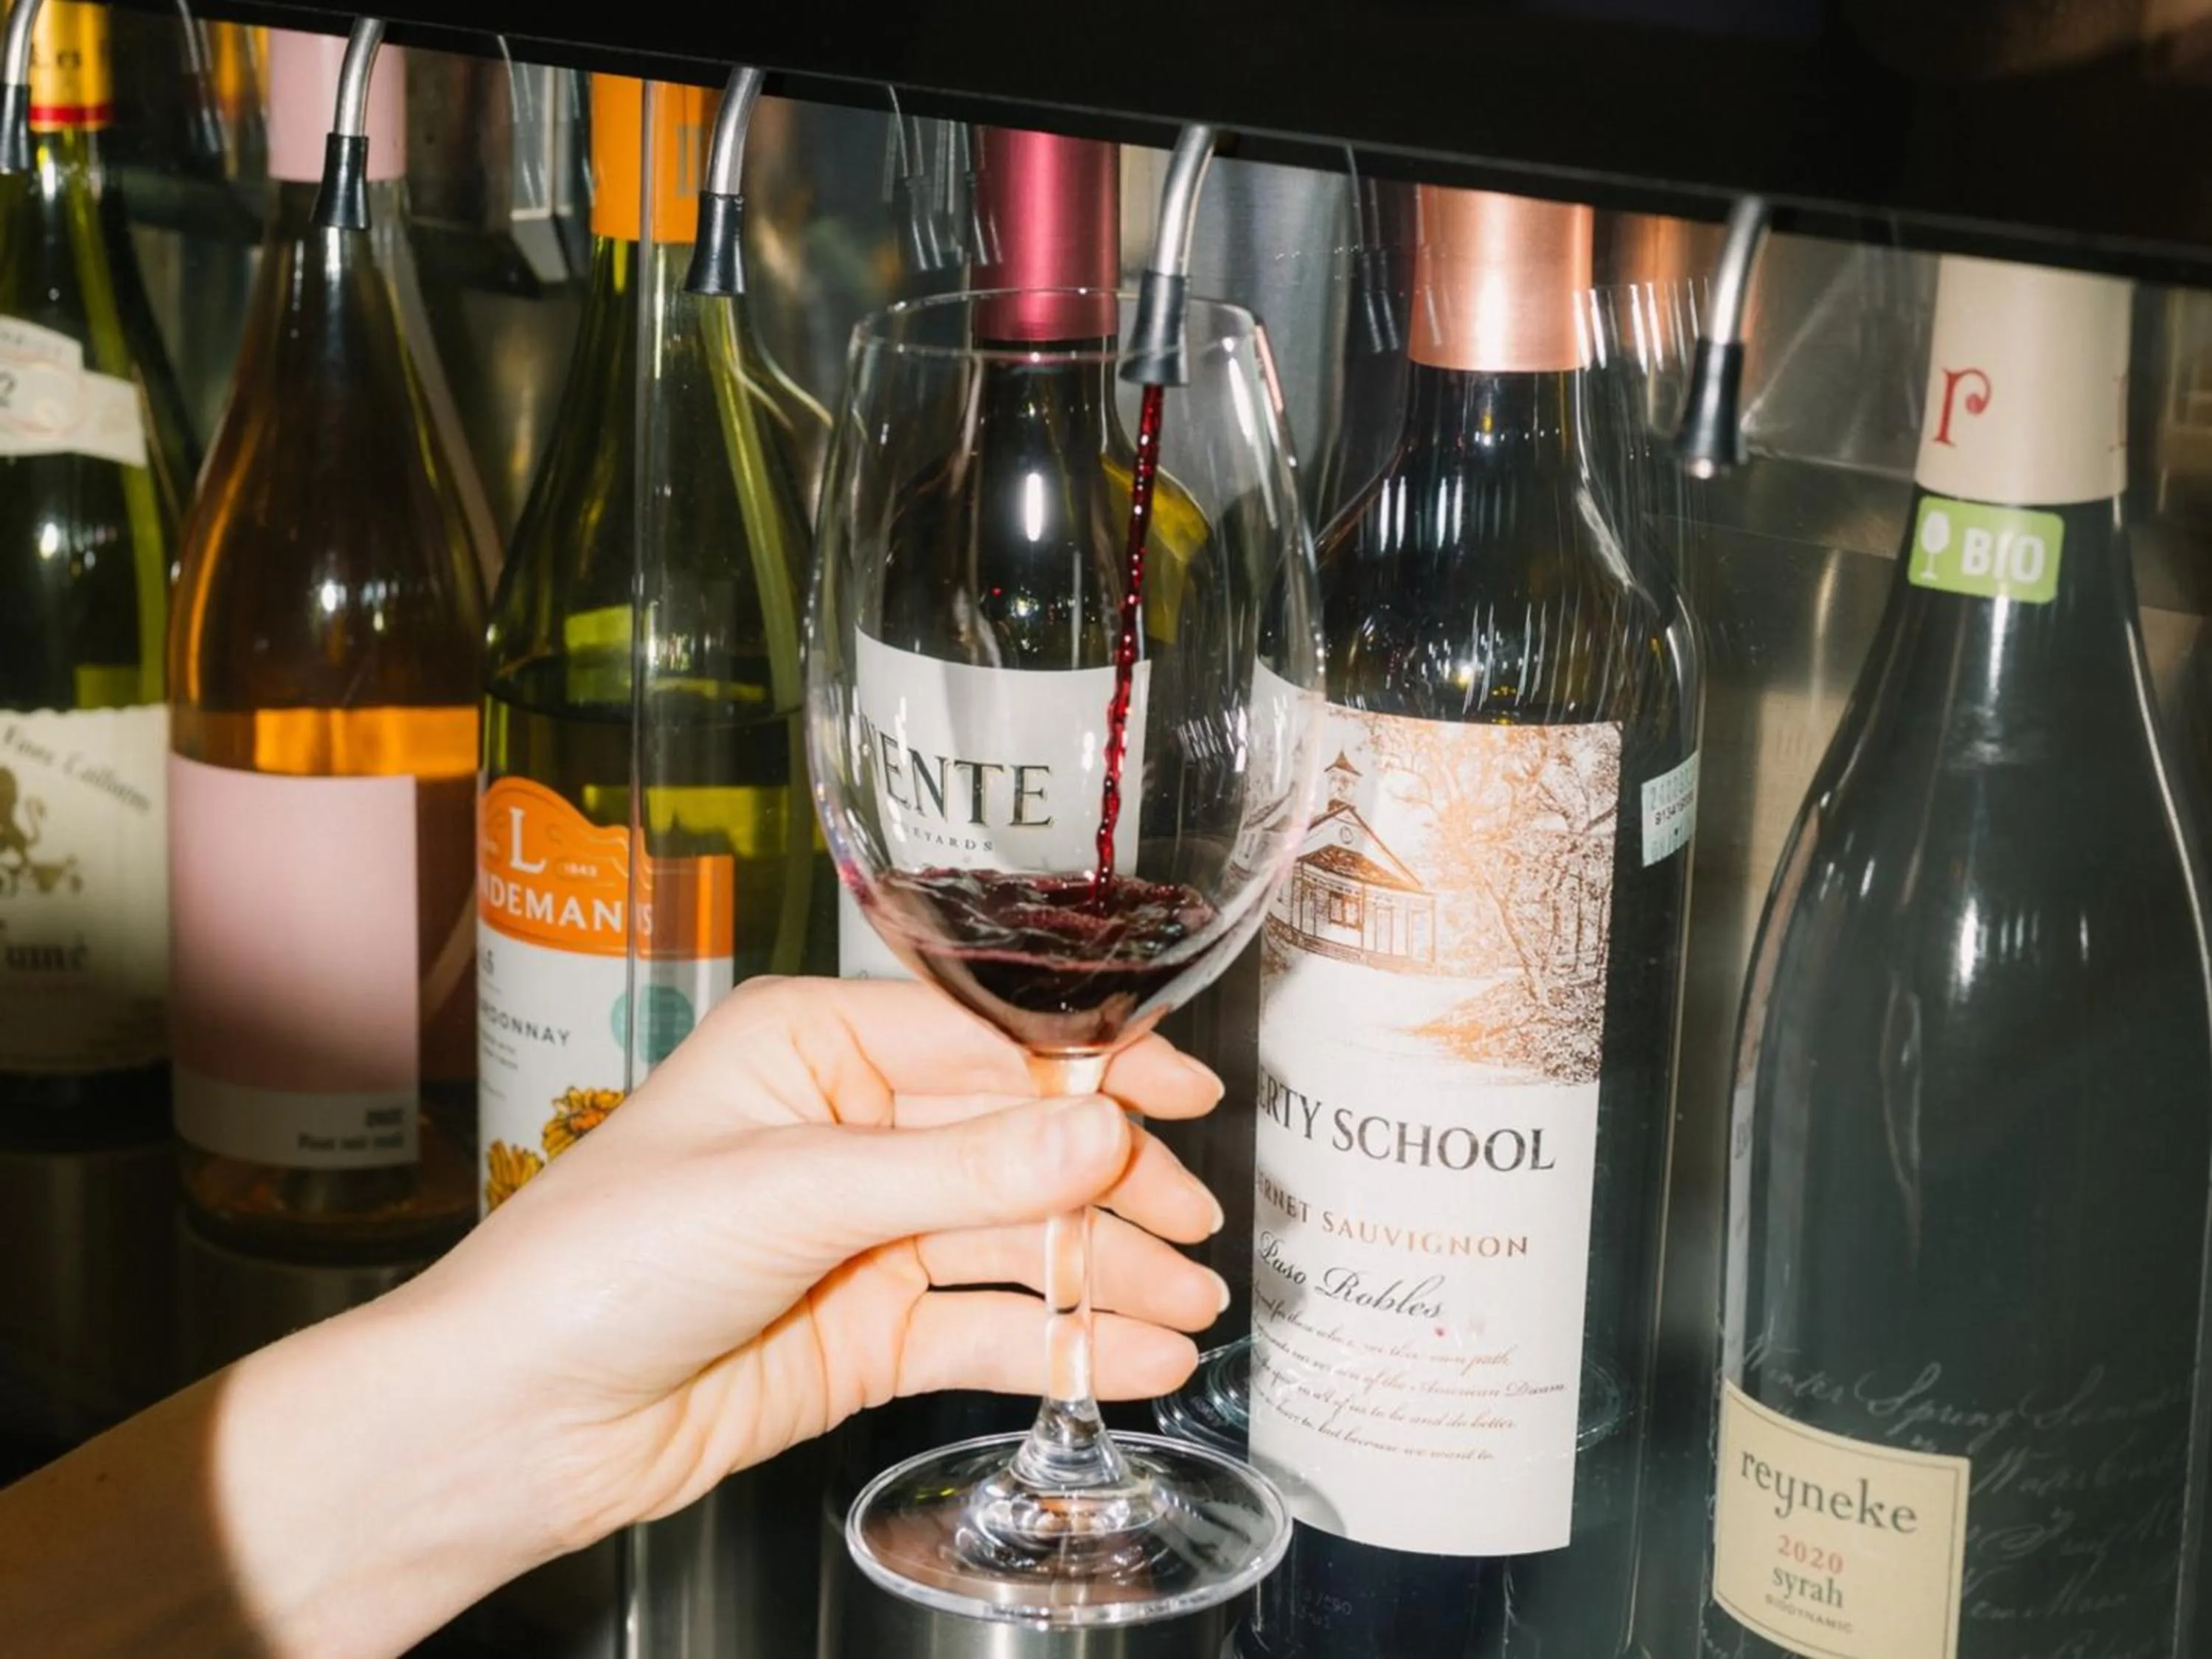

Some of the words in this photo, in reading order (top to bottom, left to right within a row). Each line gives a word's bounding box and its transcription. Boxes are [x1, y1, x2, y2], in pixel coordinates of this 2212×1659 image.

[1961, 526, 2045, 585] BIO
[509, 806, 547, 874] L
[1332, 1107, 1557, 1172] SCHOOL
[1322, 1211, 1528, 1258] SAUVIGNON
[1256, 1230, 1307, 1285] Paso
[1314, 1266, 1447, 1320] Robles
[1741, 1450, 1919, 1534] reyneke
[1777, 1534, 1845, 1575] 2020
[1772, 1566, 1844, 1609] syrah
